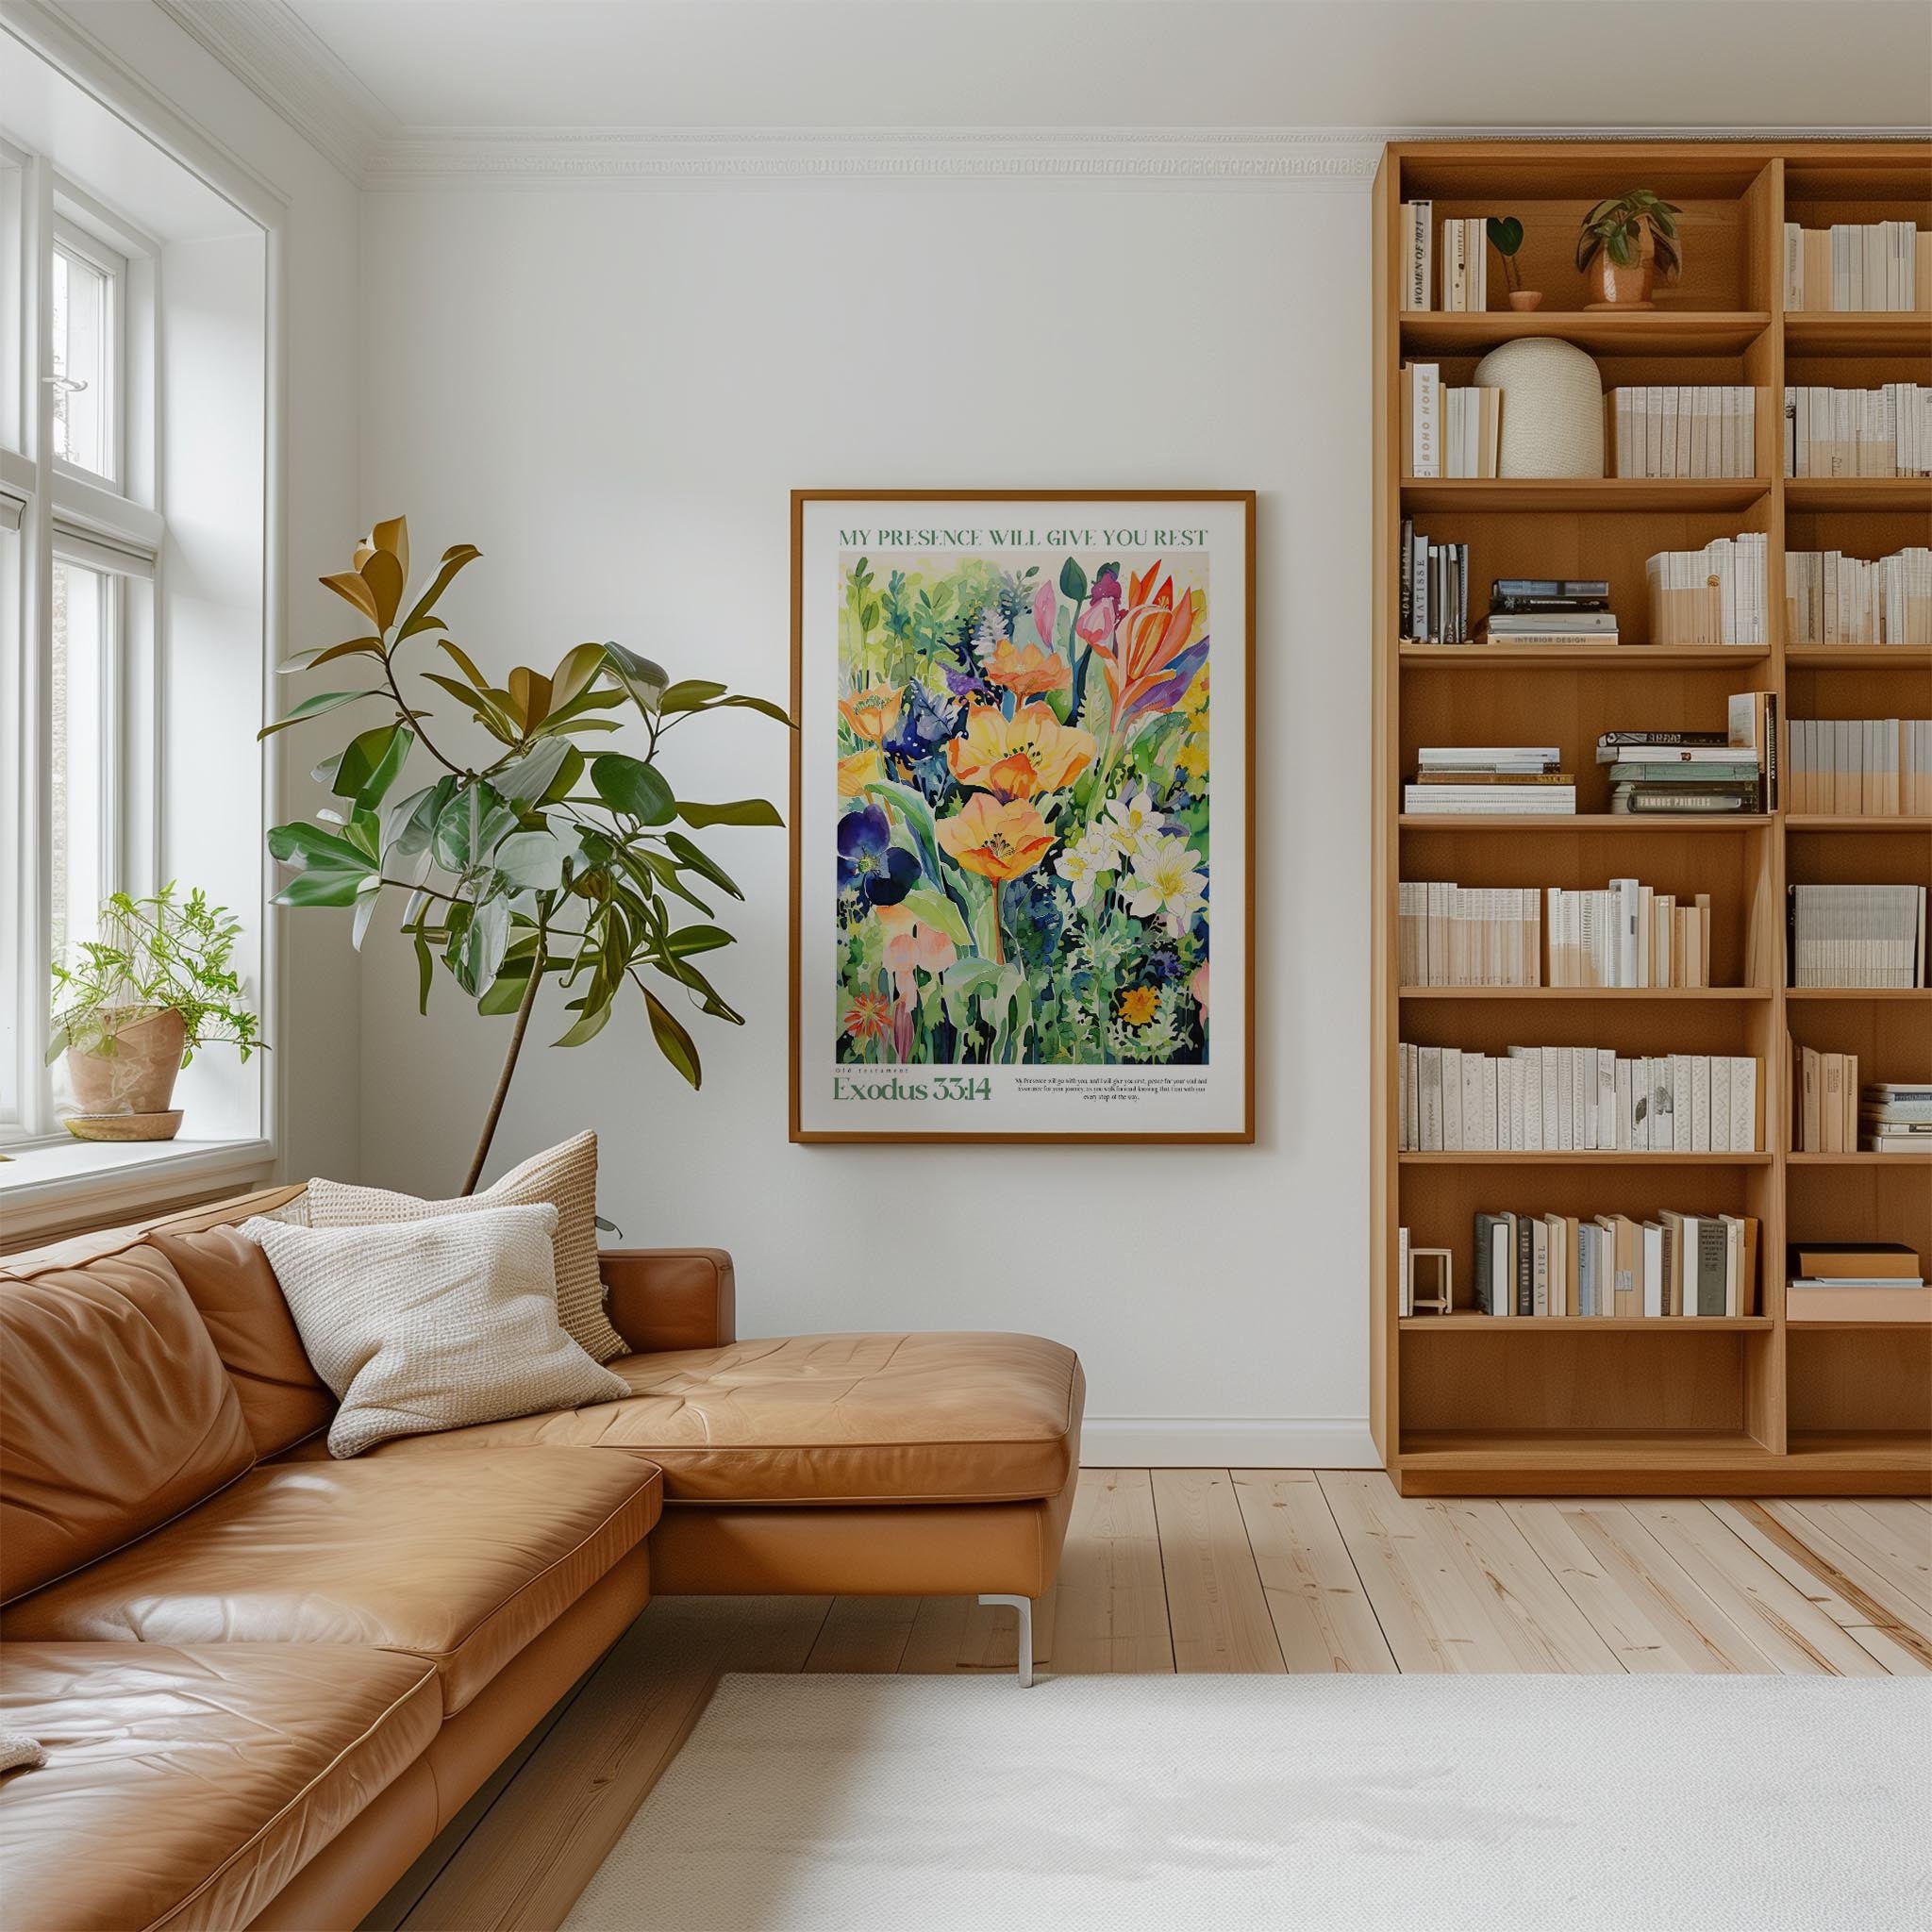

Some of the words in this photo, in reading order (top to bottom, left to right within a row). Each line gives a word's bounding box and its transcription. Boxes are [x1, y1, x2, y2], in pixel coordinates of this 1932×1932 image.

[1414, 220, 1424, 243] 2024
[1414, 243, 1424, 260] OF
[1414, 262, 1424, 305] WOMEN
[1422, 375, 1430, 415] HOME
[1422, 422, 1430, 461] BOHO
[840, 530, 872, 546] MY
[878, 530, 983, 546] PRESENCE
[990, 530, 1041, 546] WILL
[1047, 530, 1097, 546] GIVE
[1102, 530, 1148, 546] YOU
[1155, 530, 1208, 546] REST
[1416, 558, 1424, 624] MATISSE
[1640, 797, 1672, 807] FAMOUS
[1674, 797, 1711, 807] PAINTERS
[833, 1077, 929, 1101] Exodus
[932, 1077, 991, 1101] 33:14
[1538, 1245, 1546, 1274] BIEL
[1538, 1282, 1546, 1306] IVY
